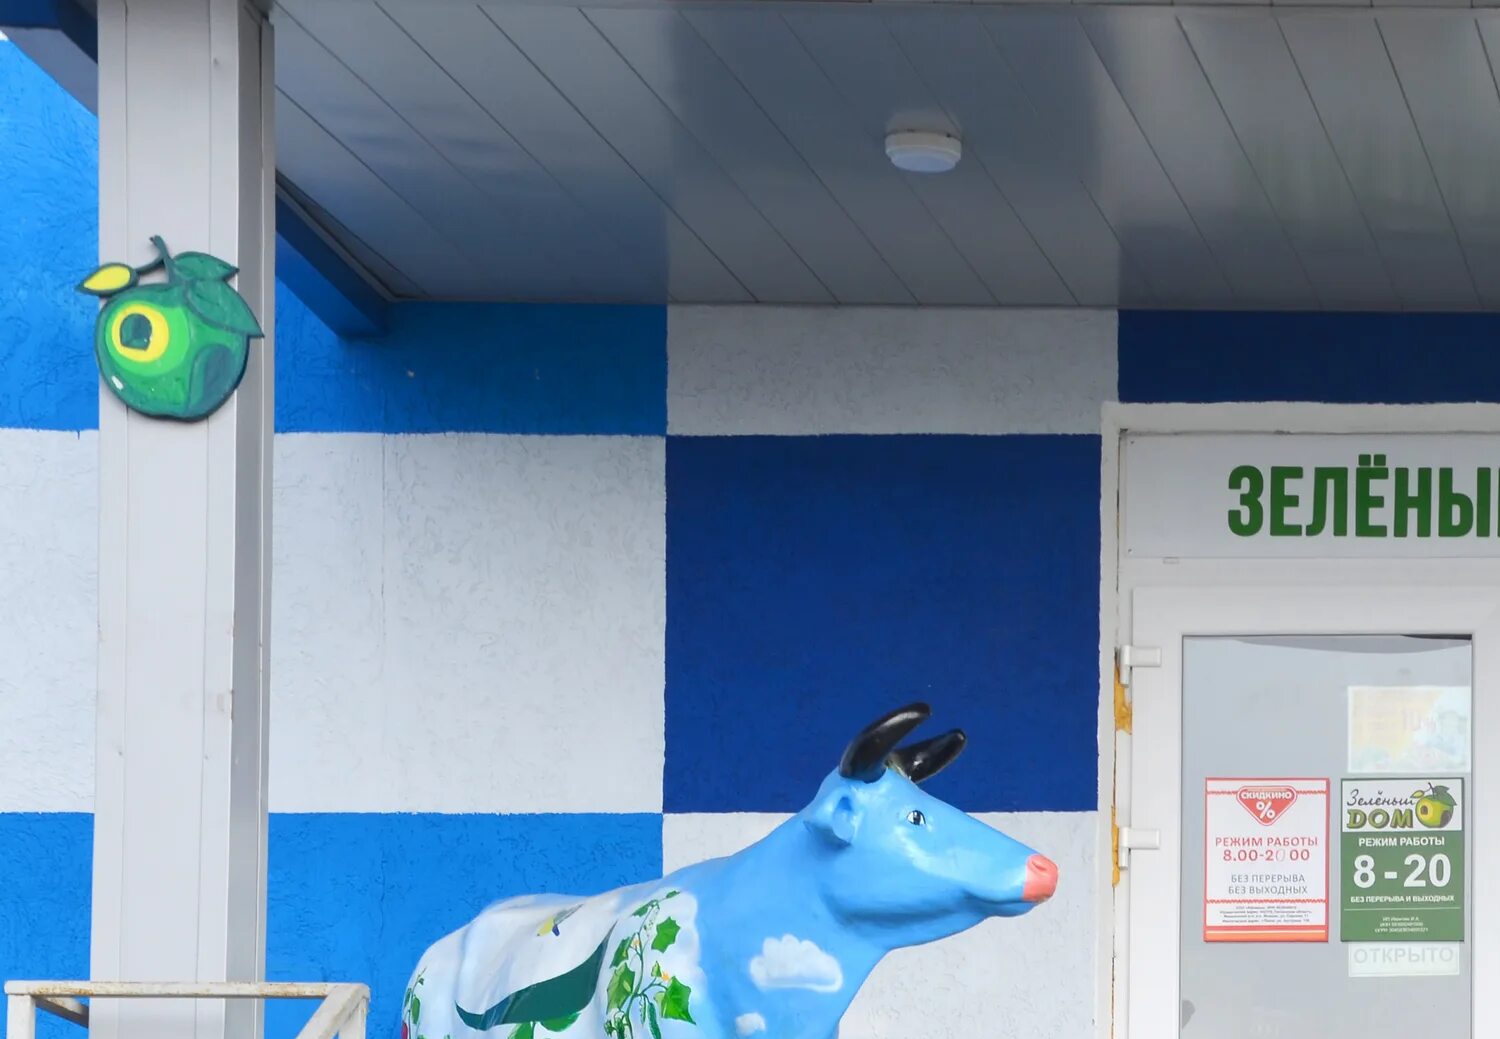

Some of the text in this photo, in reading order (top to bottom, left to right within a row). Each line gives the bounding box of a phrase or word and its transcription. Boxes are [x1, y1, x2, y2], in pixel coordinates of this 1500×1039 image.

[1240, 791, 1293, 800] СКИДКИНО
[1215, 836, 1318, 847] РЕЖИМ РАБОТЫ
[1358, 836, 1445, 847] РЕЖИМ РАБОТЫ
[1231, 874, 1305, 883] БЕЗ ПЕРЕРЫВА
[1228, 885, 1308, 895] БЕЗ ВЫХОДНЫХ
[1413, 895, 1455, 903] ВЫХОДНЫХ
[1353, 947, 1454, 964] ОТКРЫТО
